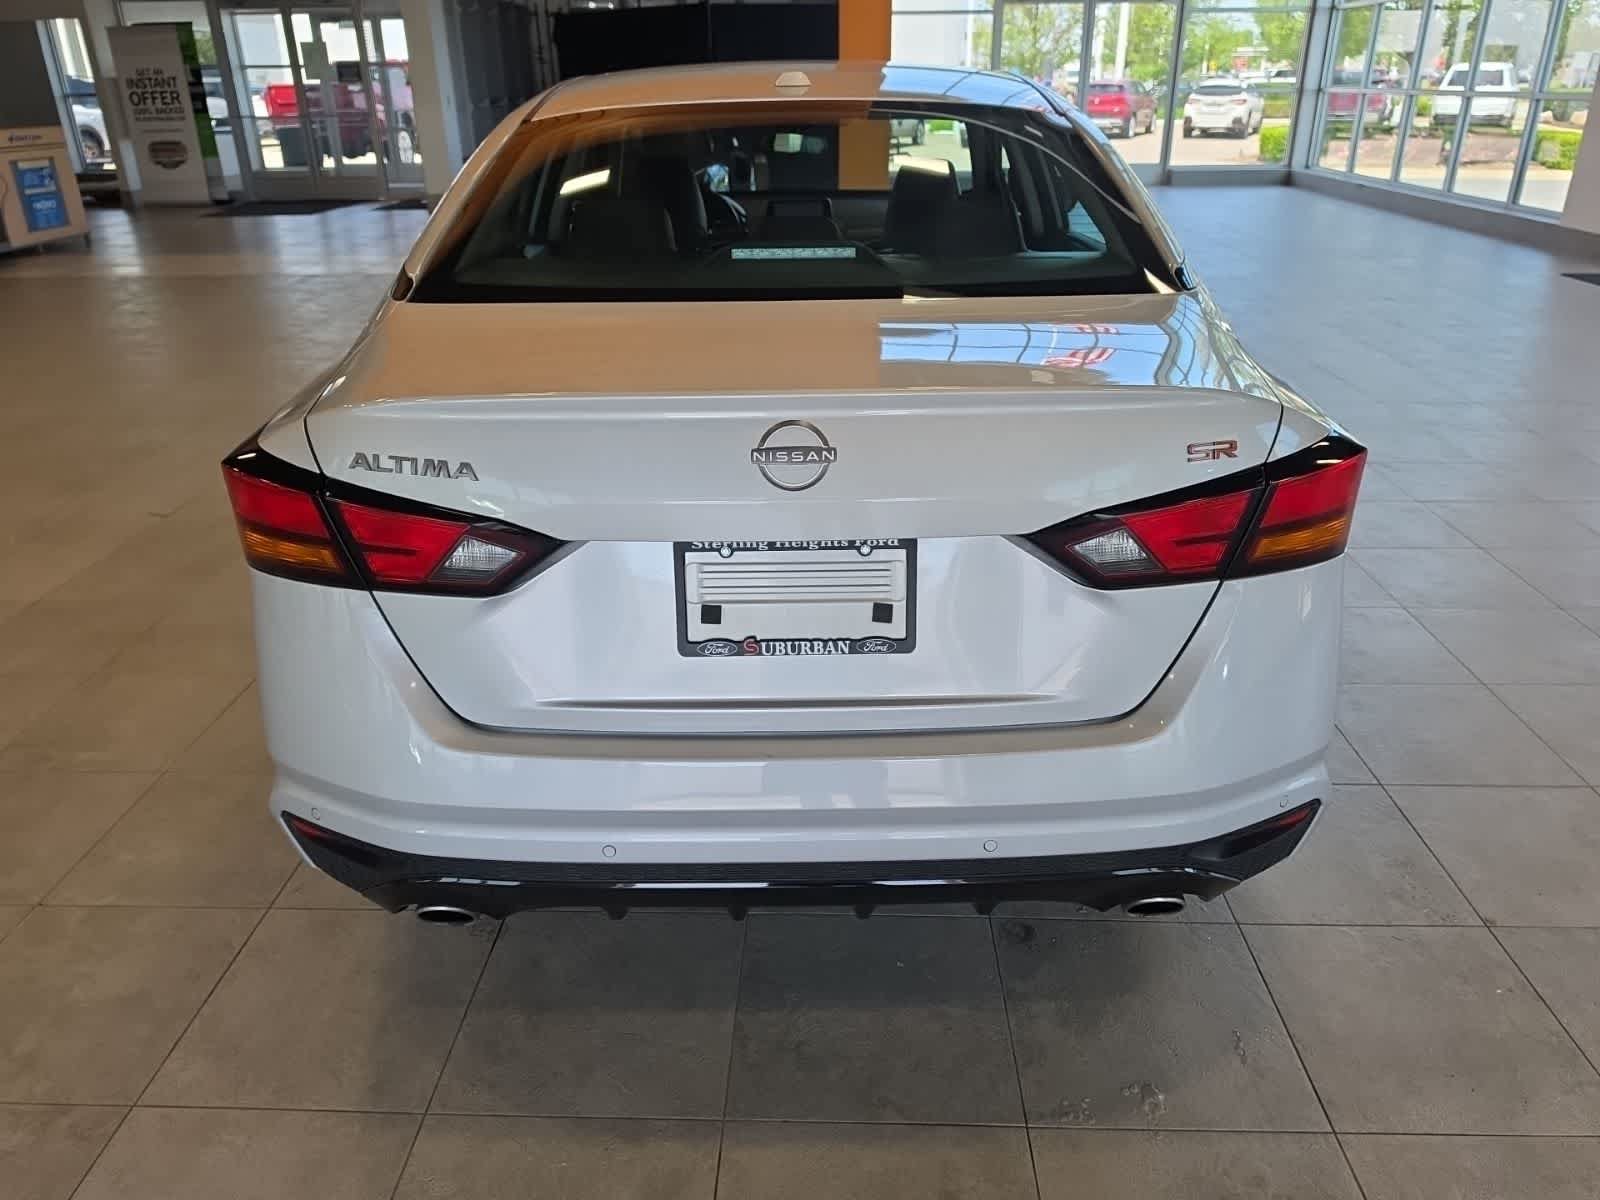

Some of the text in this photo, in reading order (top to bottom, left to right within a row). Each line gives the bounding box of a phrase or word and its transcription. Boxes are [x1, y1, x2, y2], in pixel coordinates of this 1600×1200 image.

[126, 76, 177, 90] INSTANT
[129, 90, 182, 106] OFFER
[752, 449, 835, 463] NISSAN
[1186, 439, 1239, 463] SR
[348, 451, 480, 482] ALTIMA
[743, 638, 851, 656] SUBURBAN
